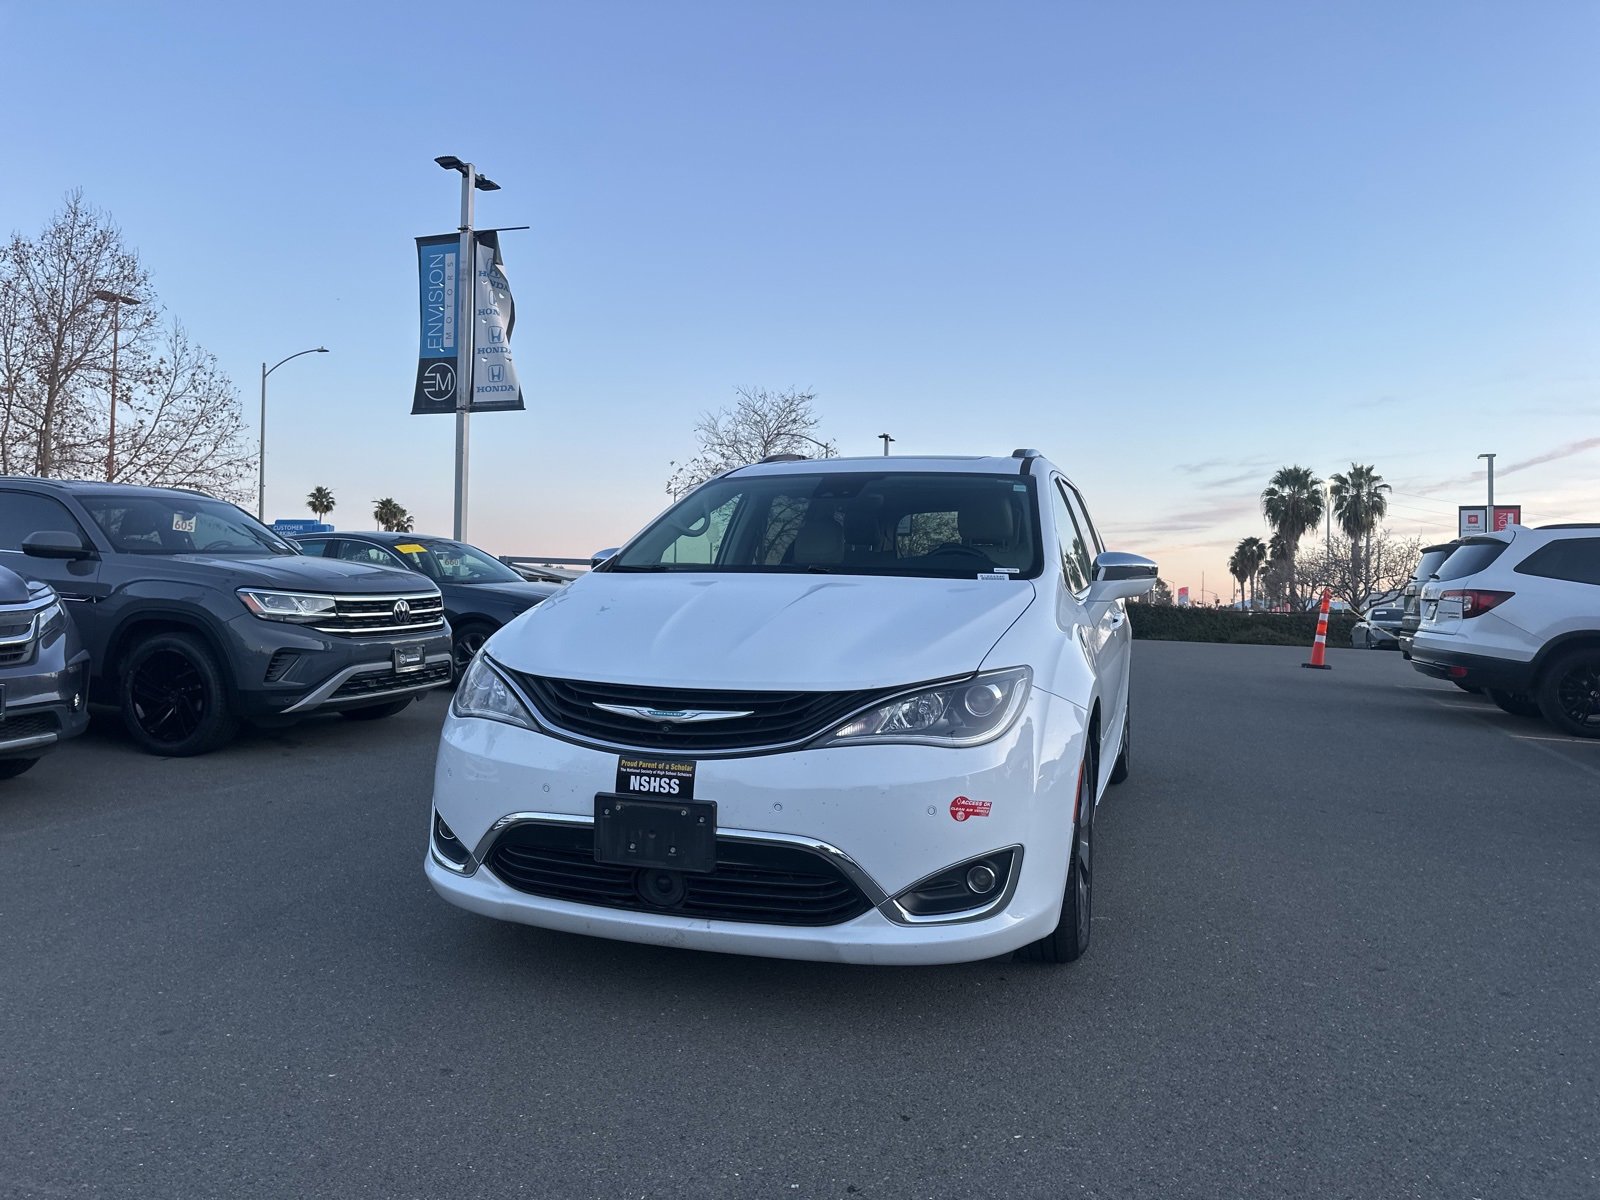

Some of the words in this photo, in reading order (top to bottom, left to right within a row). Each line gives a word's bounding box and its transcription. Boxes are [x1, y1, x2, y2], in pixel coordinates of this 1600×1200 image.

[428, 253, 444, 349] ENVISION
[445, 261, 454, 340] MOTORS
[476, 384, 516, 393] HONDA
[174, 520, 193, 531] 605
[621, 759, 637, 767] Proud
[639, 761, 657, 769] Parent
[671, 763, 693, 772] Scholar
[629, 775, 680, 794] NSHSS
